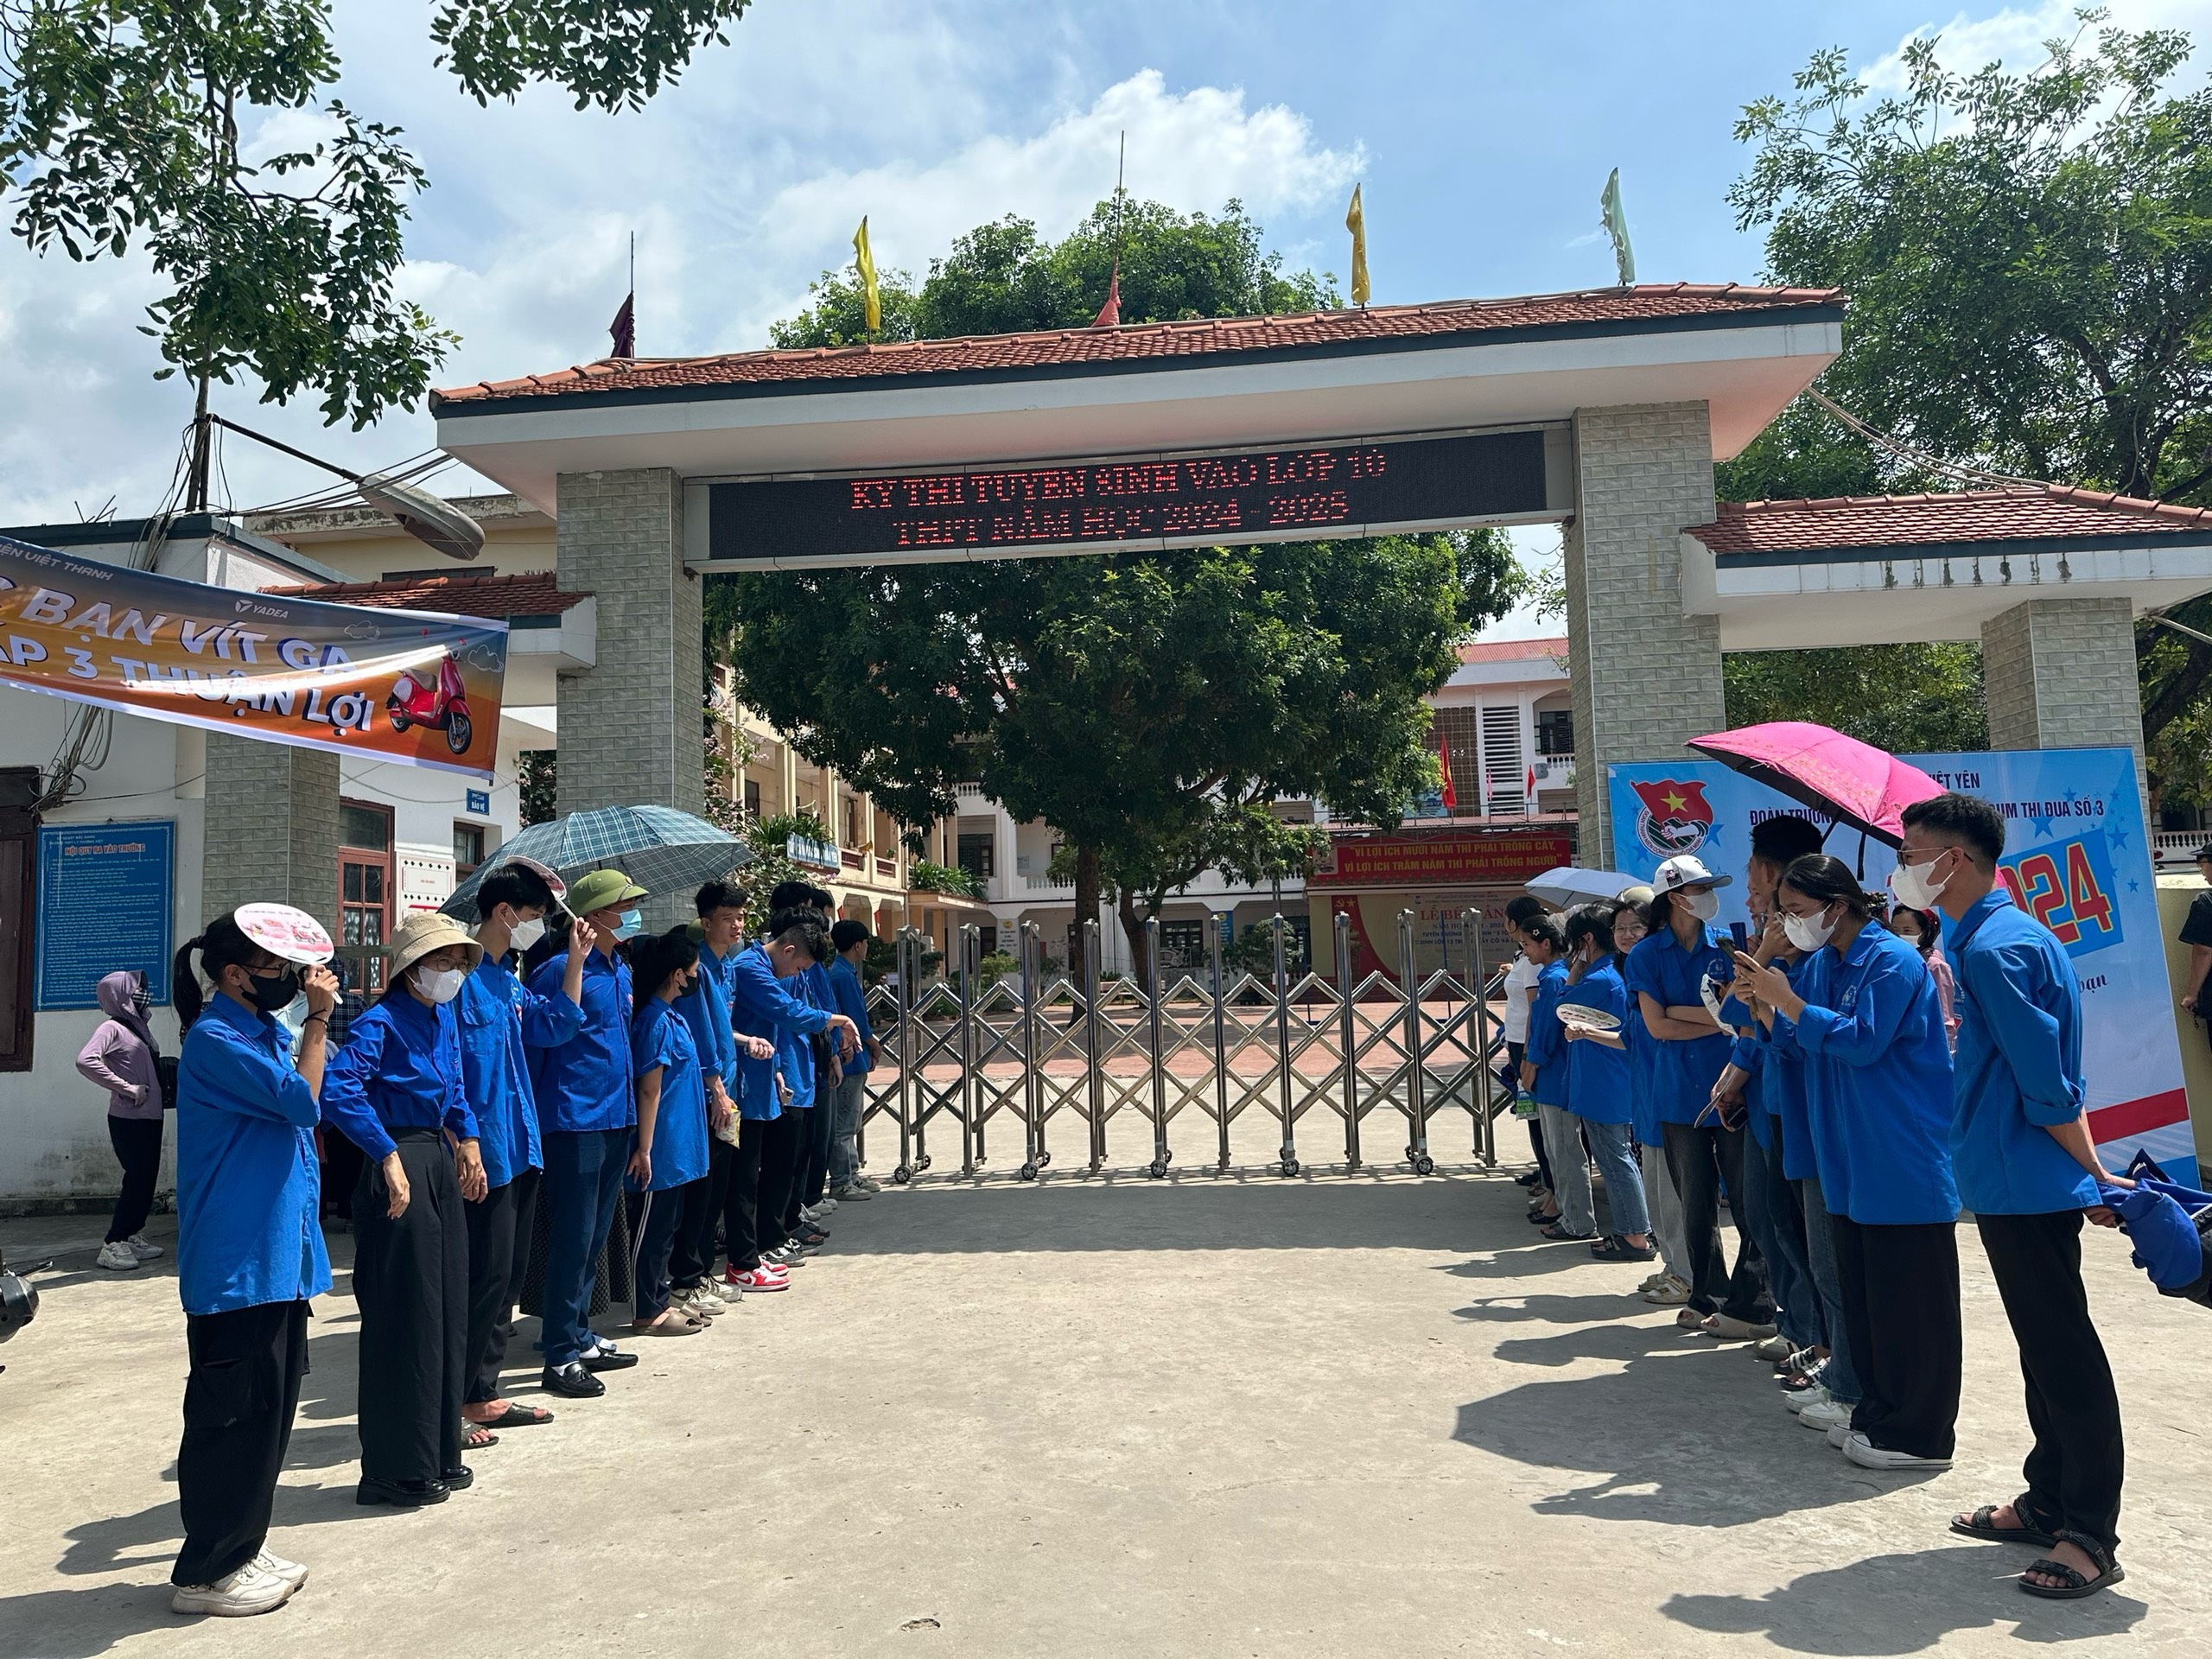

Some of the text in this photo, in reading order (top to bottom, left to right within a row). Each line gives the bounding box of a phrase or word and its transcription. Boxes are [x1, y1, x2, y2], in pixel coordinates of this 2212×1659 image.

[902, 476, 964, 506] THI
[1095, 463, 1179, 497] SINH
[1347, 448, 1386, 478] 10
[892, 518, 983, 545] THPT
[1081, 505, 1154, 540] HỌC
[1162, 498, 1242, 531] 2024
[1268, 490, 1349, 524] 2025
[0, 543, 114, 581] ỆN VIỆT THANH
[252, 604, 289, 619] YADEA
[19, 587, 358, 675] BẠN VÍT GA
[64, 645, 99, 680] 3
[302, 687, 375, 736] LỢI
[1955, 769, 1980, 790] YÊN
[2020, 802, 2041, 818] THI
[2044, 800, 2071, 818] ĐUA
[2074, 794, 2093, 816] SỐ
[2095, 800, 2105, 817] 3
[65, 842, 146, 857] NỘI QUY RA VÀO TRƯỜNG
[1422, 858, 1446, 870] NĂM
[1465, 855, 1487, 868] PHẢI
